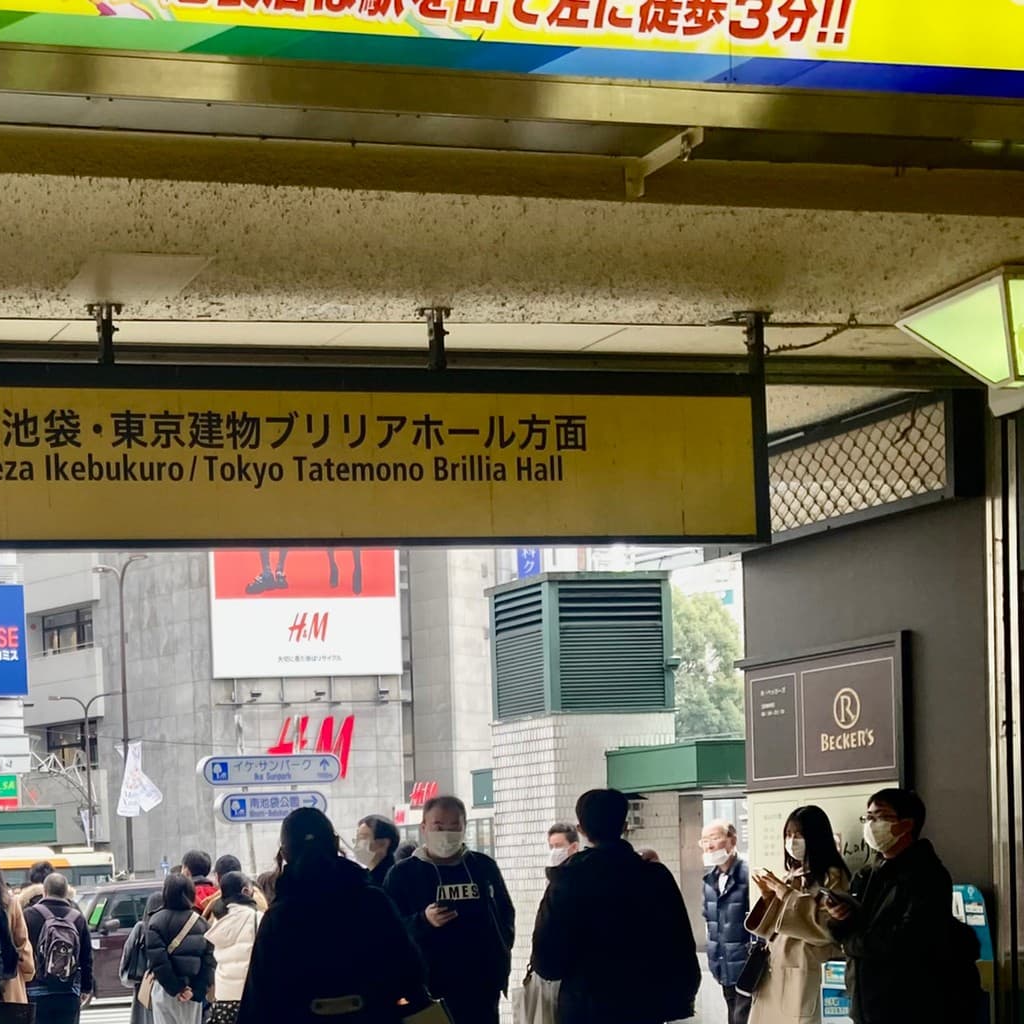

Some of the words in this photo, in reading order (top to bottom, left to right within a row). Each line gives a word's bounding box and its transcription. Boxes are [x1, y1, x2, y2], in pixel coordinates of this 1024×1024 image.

[293, 457, 423, 482] Tatemono
[434, 456, 506, 482] Brillia
[517, 456, 563, 482] Hall
[288, 612, 329, 642] H&M
[820, 728, 875, 751] BECKER'S
